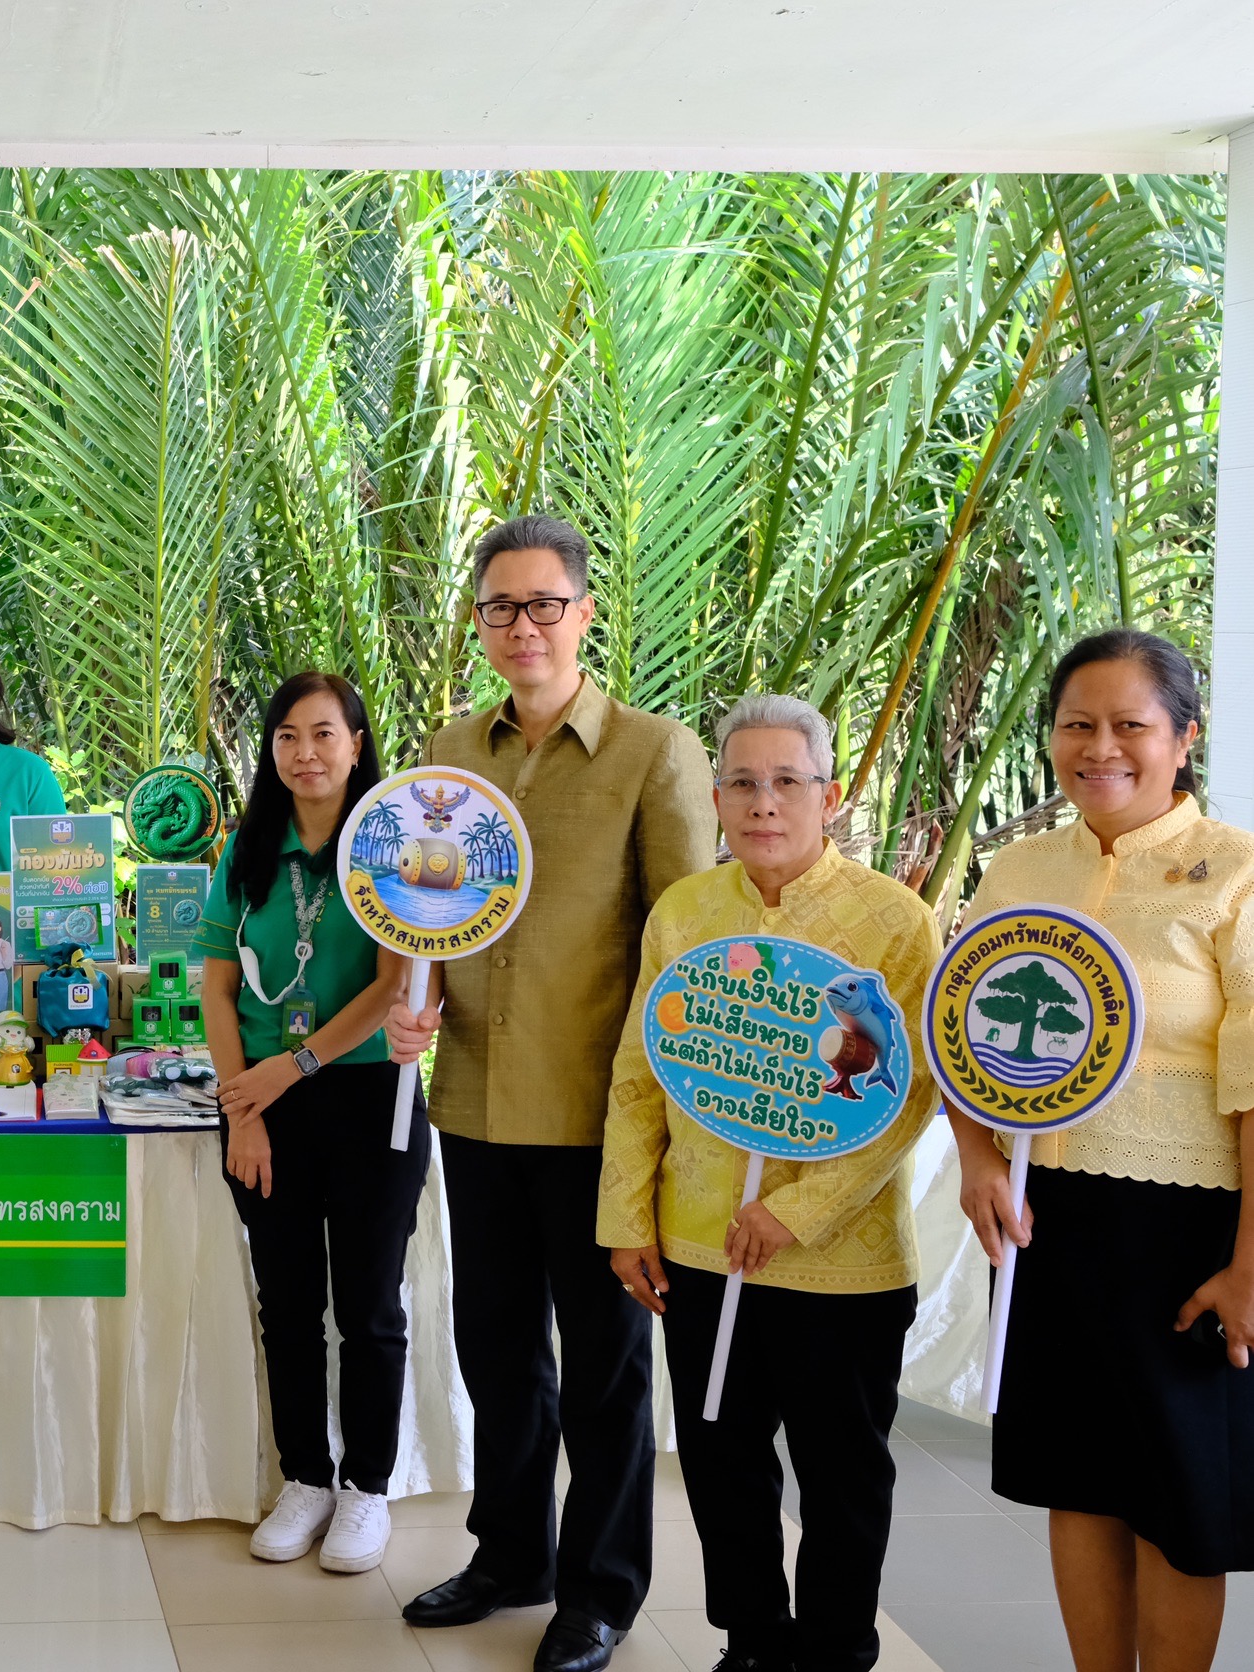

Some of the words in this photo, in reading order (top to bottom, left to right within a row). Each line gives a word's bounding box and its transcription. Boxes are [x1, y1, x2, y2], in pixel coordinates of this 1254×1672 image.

[19, 843, 106, 871] ทองพันชั่ง
[52, 875, 84, 896] 2%
[84, 881, 109, 894] ต่อปี
[354, 884, 511, 952] จังหวัดสมุทรสงคราม
[944, 922, 1125, 1027] กลุ่มออมทรัพย์เพื่อการผลิต
[683, 992, 809, 1055] ไม่เสียหาย
[659, 1036, 823, 1099] แต่ถ้าไม่เก็บไว้
